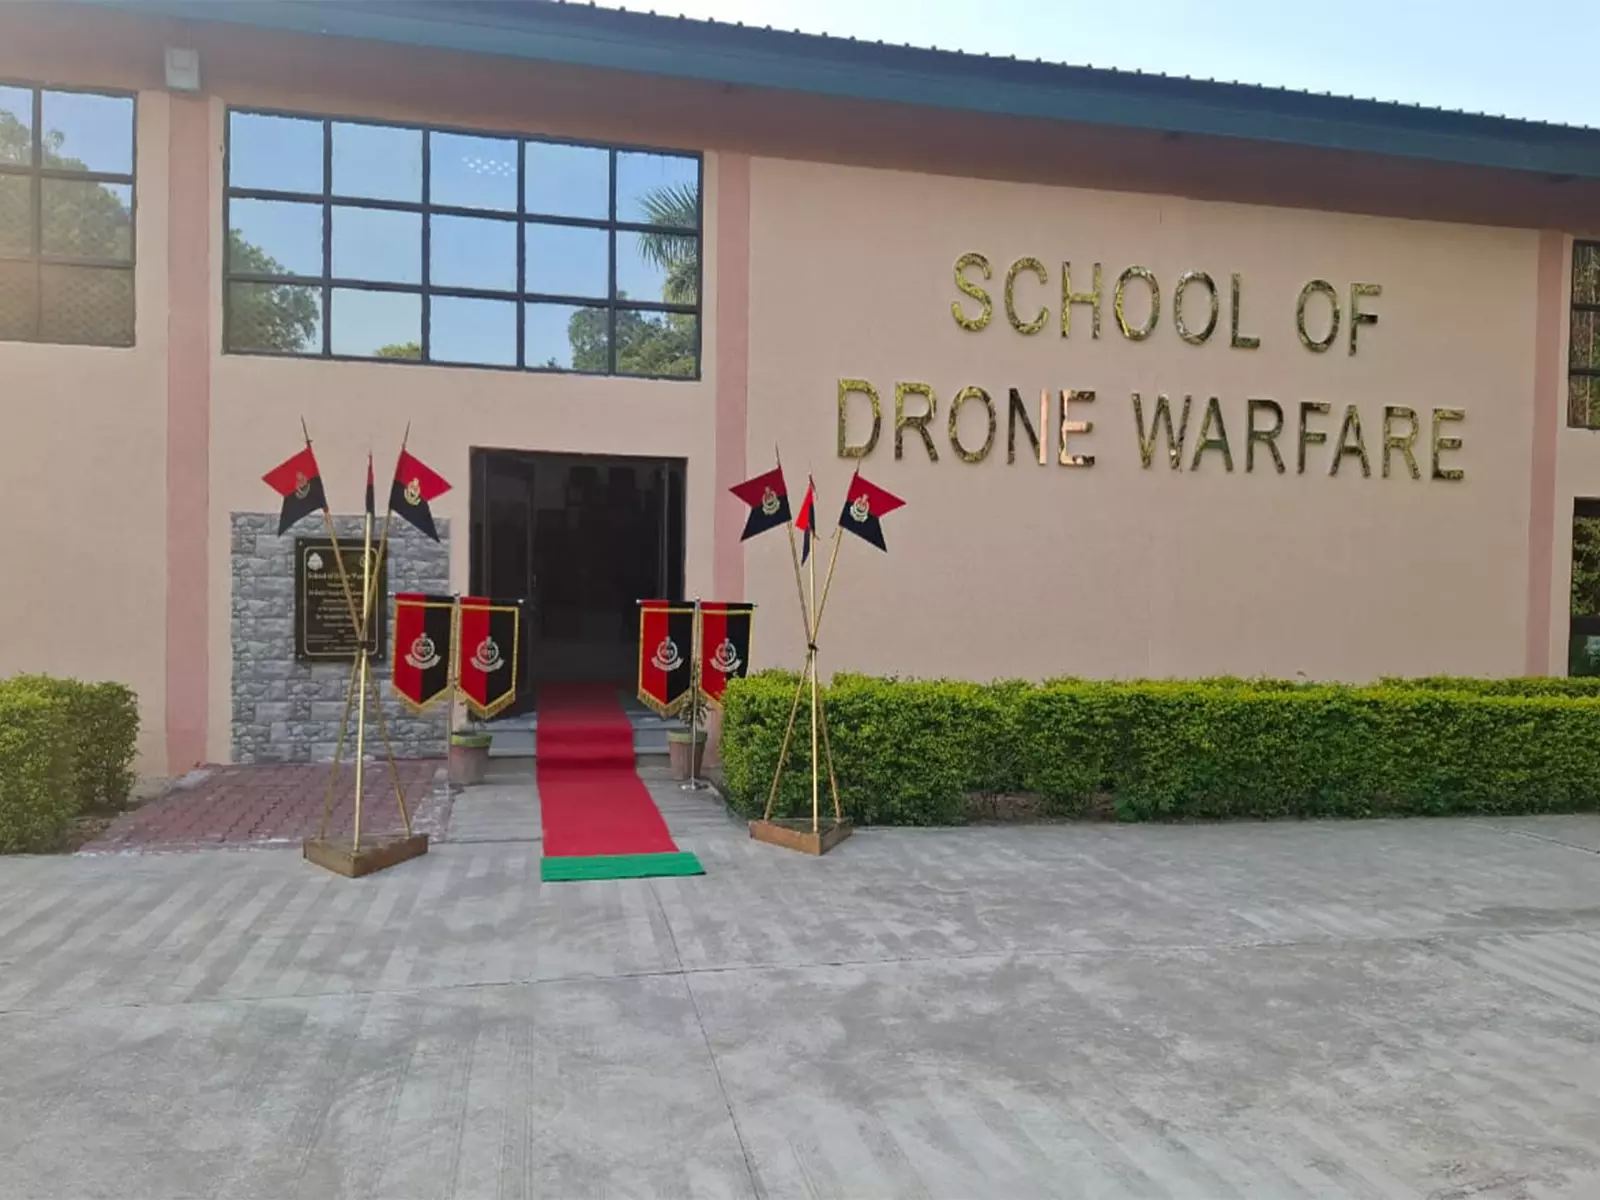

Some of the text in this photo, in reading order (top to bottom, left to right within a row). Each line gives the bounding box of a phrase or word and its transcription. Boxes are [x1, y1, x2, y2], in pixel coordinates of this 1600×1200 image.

[951, 252, 1383, 357] SCHOOL OF
[837, 378, 1466, 481] DRONE WARFARE
